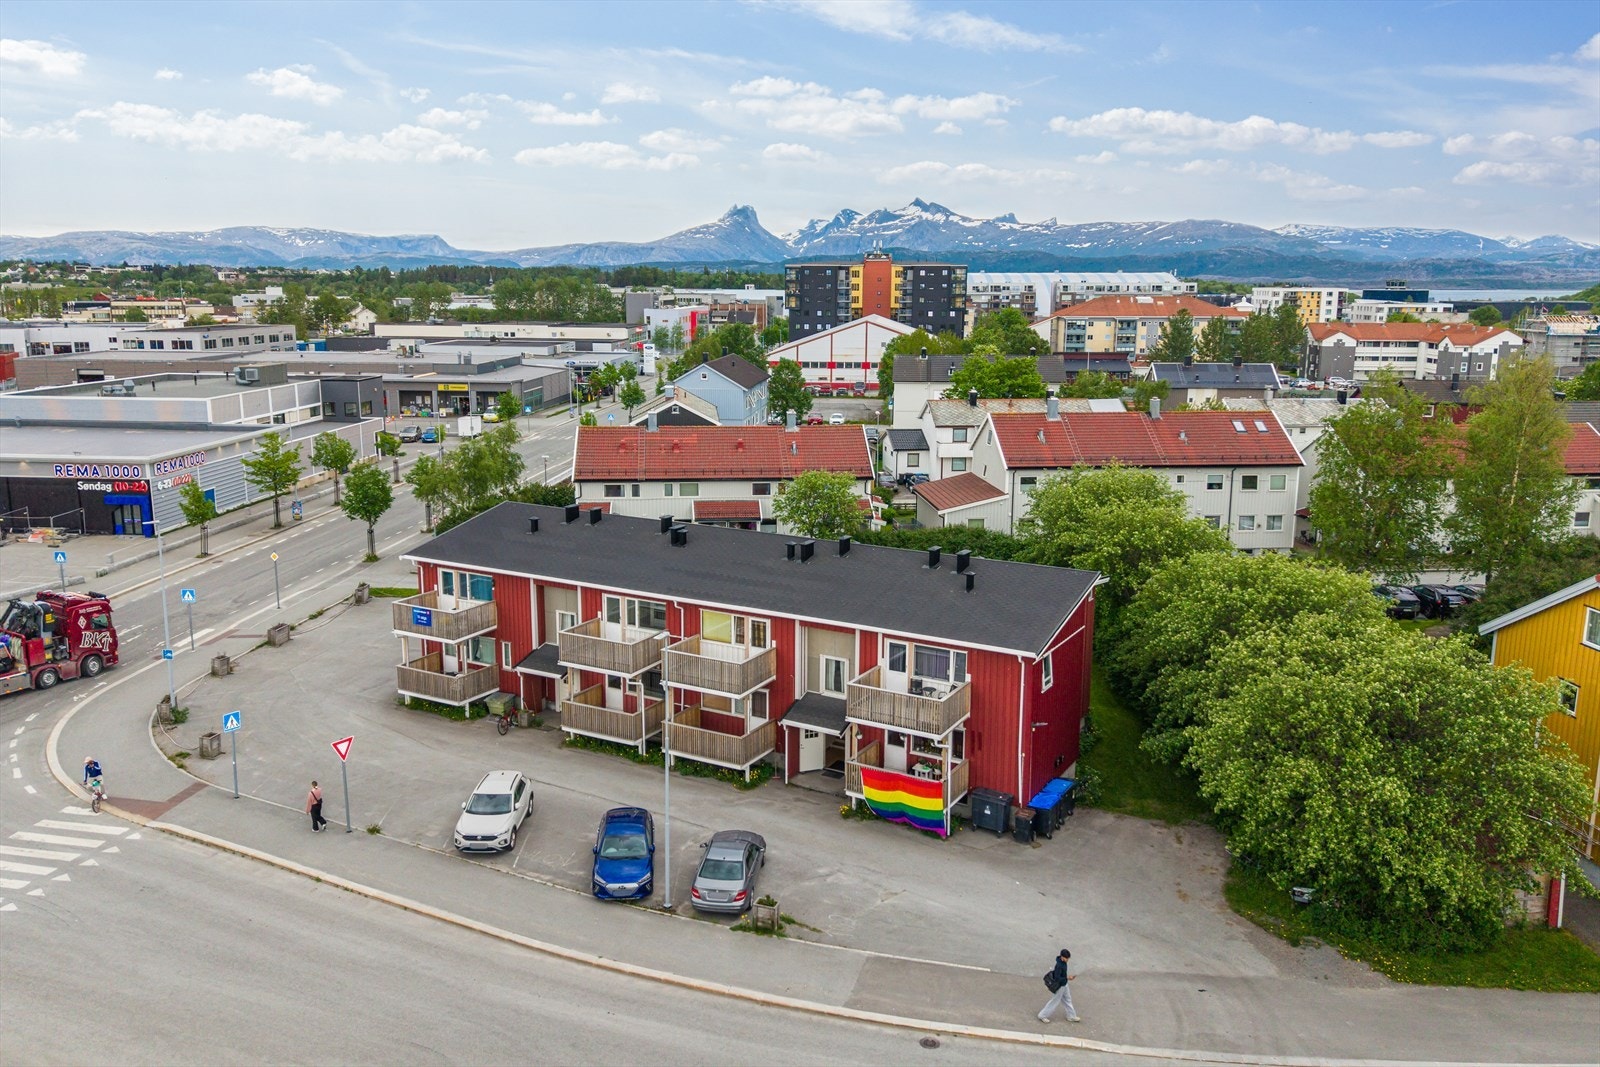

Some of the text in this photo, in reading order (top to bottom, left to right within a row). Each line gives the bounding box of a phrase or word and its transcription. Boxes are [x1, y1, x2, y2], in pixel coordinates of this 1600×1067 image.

[155, 452, 205, 475] REMA 1000
[54, 464, 140, 478] REMA 1000
[77, 481, 112, 492] Søndag
